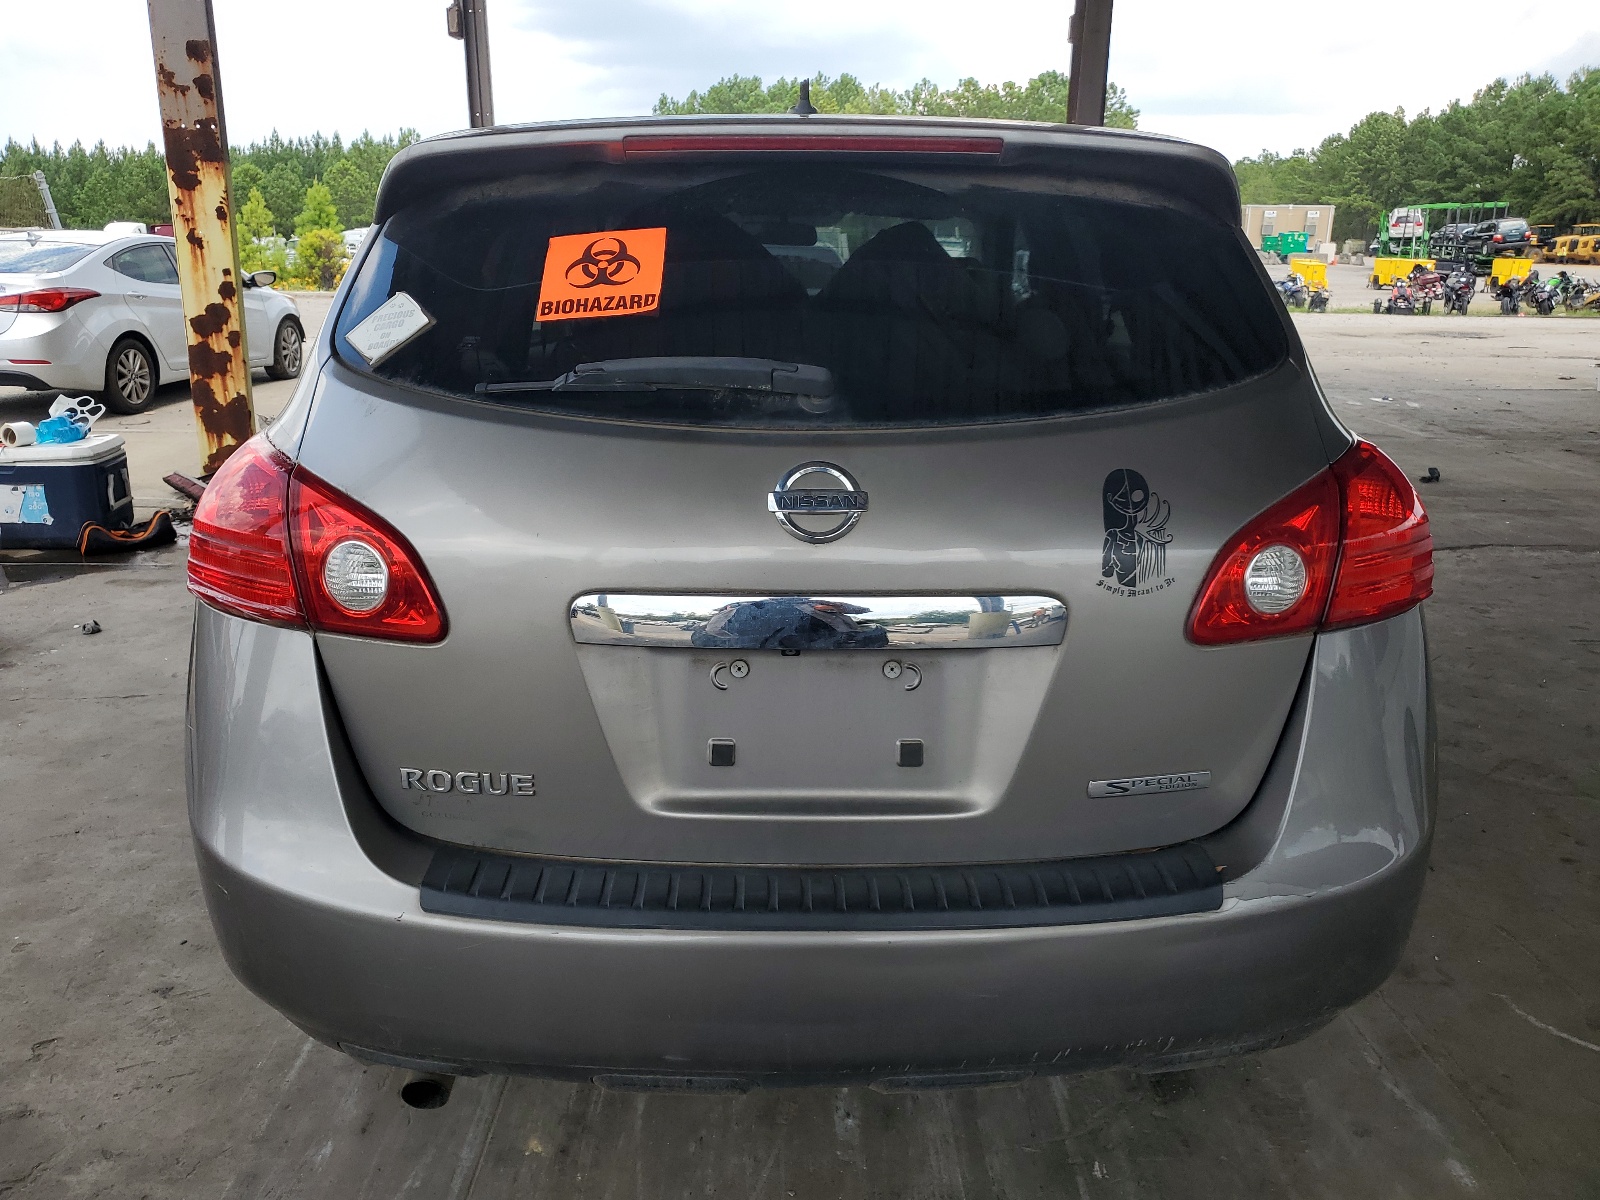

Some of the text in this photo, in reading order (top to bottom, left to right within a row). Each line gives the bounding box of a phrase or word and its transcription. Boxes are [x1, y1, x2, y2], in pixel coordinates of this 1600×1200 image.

[540, 294, 656, 316] BIOHAZARD
[372, 309, 415, 323] PRECIOUS
[373, 319, 405, 332] CARGO
[781, 494, 859, 509] NISSAN
[1096, 577, 1176, 597] Simply Meant to Be
[400, 767, 536, 796] ROGUE
[1105, 775, 1198, 795] SPECIAL
[1159, 782, 1198, 791] EDITION
